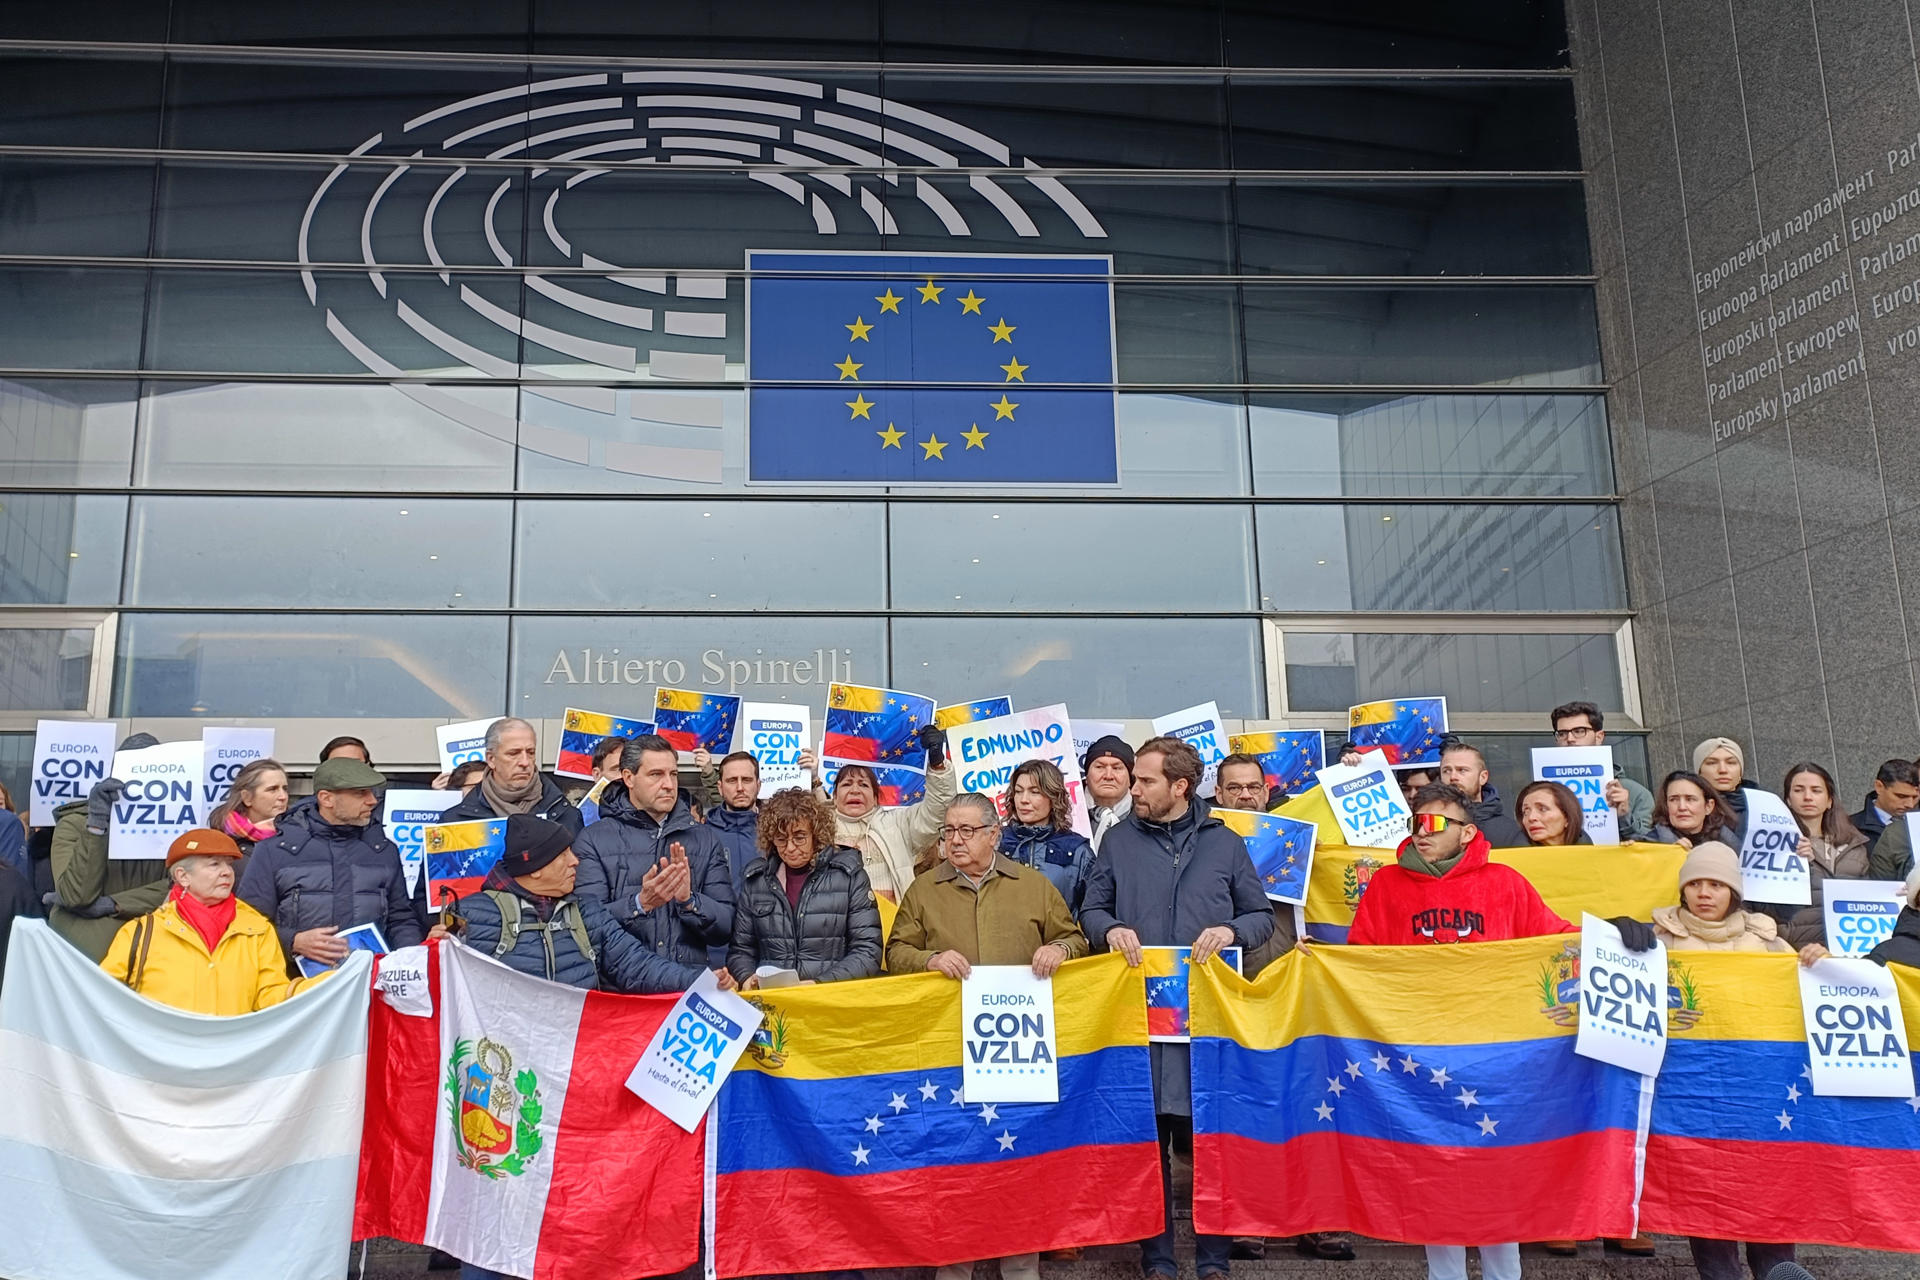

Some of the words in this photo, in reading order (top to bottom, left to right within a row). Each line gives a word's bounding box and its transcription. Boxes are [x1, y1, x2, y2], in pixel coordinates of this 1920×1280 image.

[1851, 181, 1920, 242] Ευρωπα
[1695, 229, 1782, 294] Европейски
[1784, 169, 1875, 240] парламент
[1700, 286, 1758, 331] Euroopa
[1759, 232, 1842, 296] Parlament
[1704, 317, 1765, 368] Europski
[1768, 271, 1850, 338] parlament
[1887, 325, 1920, 356] vro
[1708, 350, 1784, 405] Parlament
[1785, 312, 1861, 365] Ewropew
[1713, 396, 1779, 443] Európsky
[1783, 351, 1868, 414] parlament
[543, 648, 686, 685] Altiero
[701, 648, 853, 695] Spinelli
[762, 722, 793, 730] EUROPA
[1175, 725, 1206, 739] EUROPA
[50, 743, 99, 754] EUROPA
[458, 739, 486, 750] EUROP
[753, 733, 800, 748] CON
[961, 723, 1063, 762] EDMUNDO
[218, 749, 261, 759] EUROPA
[41, 758, 104, 779] CON
[131, 763, 187, 774] EUROPA
[210, 763, 245, 782] CO
[760, 775, 776, 783] asta
[962, 755, 1069, 793] GONZZ
[1555, 767, 1593, 776] EUROPA
[34, 779, 97, 799] VZL
[121, 779, 192, 802] CON
[1342, 776, 1375, 793] EUROPA
[1342, 785, 1390, 814] CON
[114, 804, 198, 825] VZLA
[404, 811, 441, 821] EUROPA
[1343, 801, 1405, 832] VZLA
[1752, 829, 1800, 853] CON
[1741, 850, 1806, 873] VZLA
[1847, 903, 1887, 912] EUROPA
[1412, 907, 1485, 936] CHICAGO
[1838, 916, 1897, 934] CON
[1596, 947, 1648, 973] EUROPA
[1589, 966, 1657, 1008] CON
[1819, 985, 1880, 998] EUROPA
[981, 994, 1035, 1006] EUROPA
[694, 1001, 729, 1032] EUROPA
[973, 1013, 1044, 1039] CON
[1583, 990, 1664, 1038] VZLA
[1815, 1004, 1893, 1031] CON
[676, 1011, 728, 1059] CON
[1811, 1032, 1906, 1058] VZLA
[662, 1027, 717, 1085] VZLA
[966, 1041, 1053, 1064] VZLA
[647, 1067, 670, 1085] Hasta
[670, 1079, 682, 1089] el
[677, 1082, 702, 1100] final
